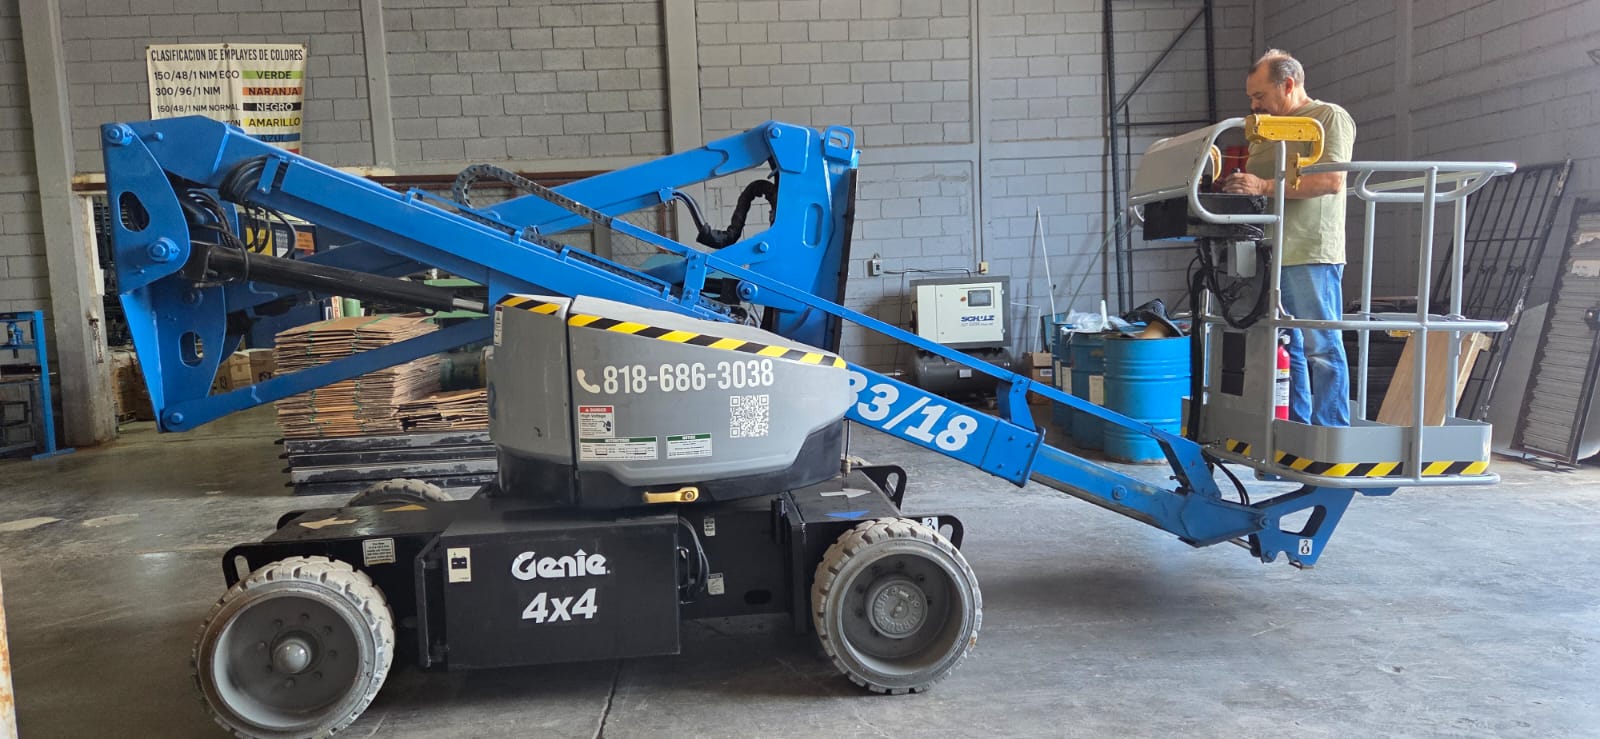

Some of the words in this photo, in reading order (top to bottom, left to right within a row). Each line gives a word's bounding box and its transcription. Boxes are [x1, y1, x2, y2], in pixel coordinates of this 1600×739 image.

[151, 49, 206, 61] CLASIFICACION
[208, 49, 218, 60] DE
[220, 49, 257, 60] EMPLAYES
[259, 49, 268, 60] DE
[270, 49, 303, 60] COLORES
[154, 70, 197, 81] 150/48/1
[199, 70, 217, 80] NIM
[256, 70, 292, 79] VERDE
[155, 86, 201, 97] 300/96/1
[203, 86, 221, 95] NIM
[248, 87, 299, 96] NARANJA
[157, 104, 192, 113] 150/48/1
[192, 104, 207, 112] NIM
[208, 103, 240, 112] NORMAL
[256, 103, 293, 111] NEGRO
[248, 117, 300, 127] AMARILLO
[603, 358, 774, 394] 818-686-3038
[511, 548, 607, 581] Genie
[522, 587, 598, 624] 4x4
